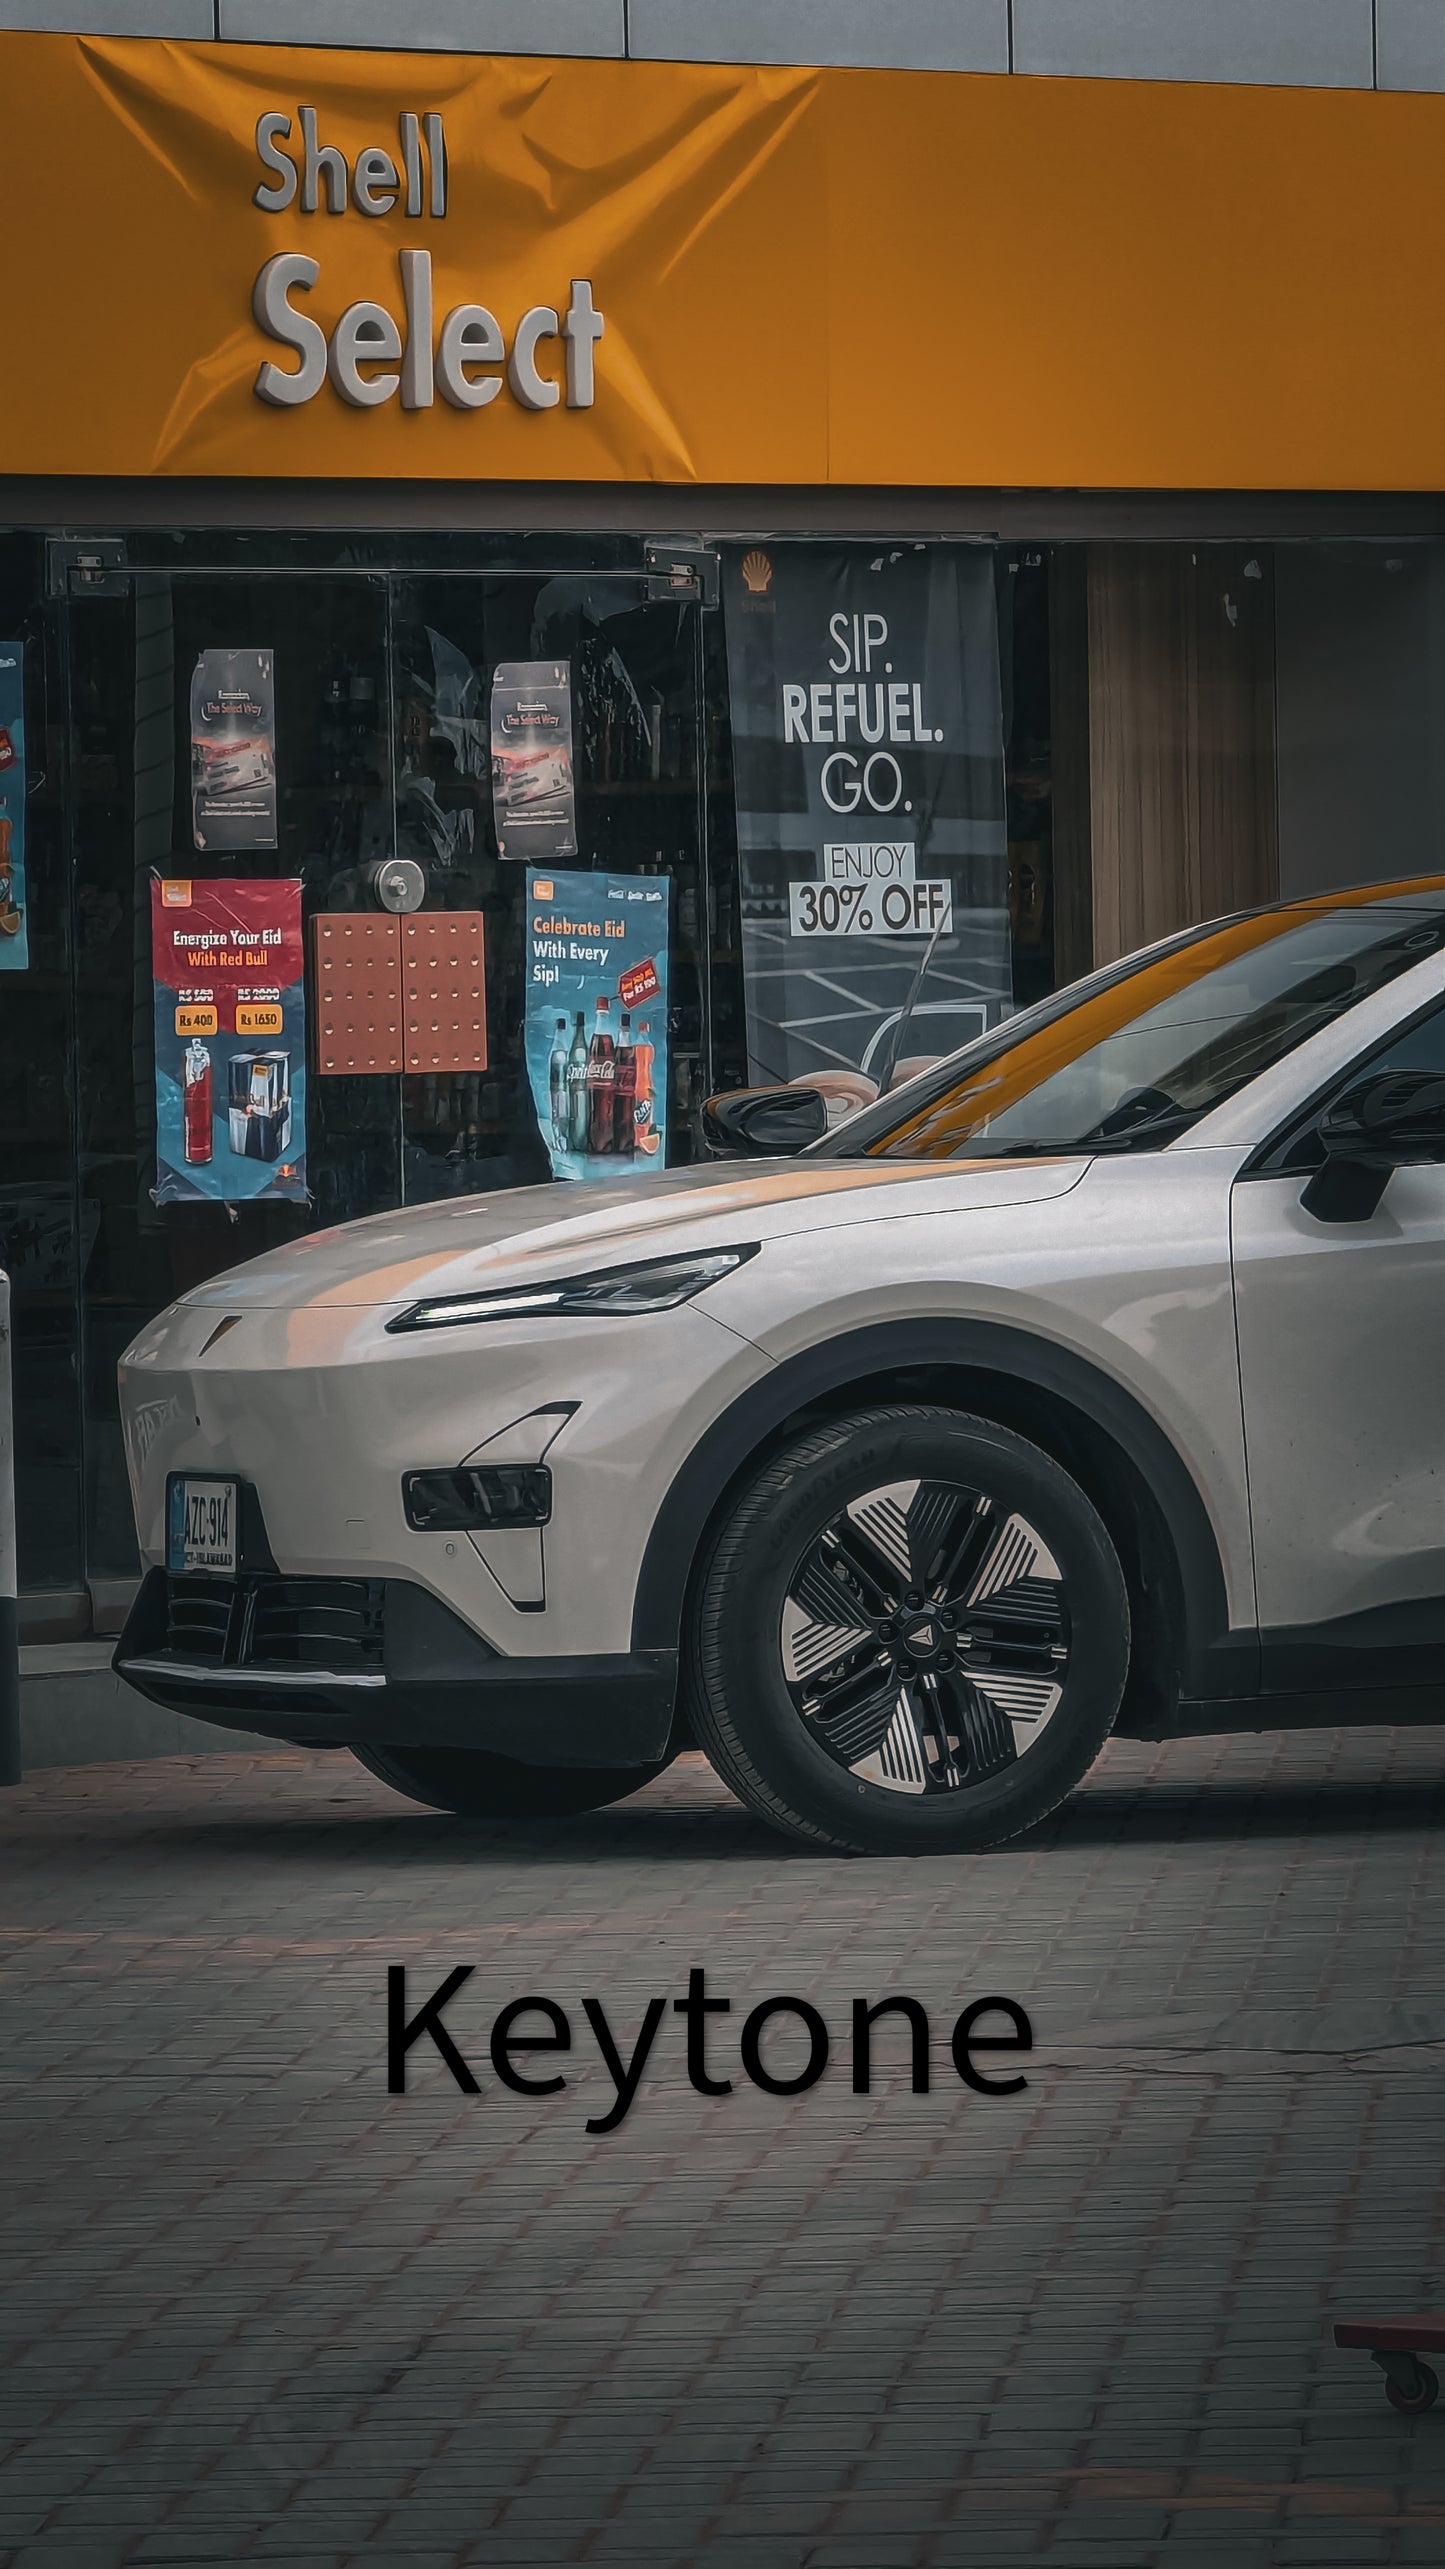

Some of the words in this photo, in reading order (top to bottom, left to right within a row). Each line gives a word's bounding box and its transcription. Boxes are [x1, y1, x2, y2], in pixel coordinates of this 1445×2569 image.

[253, 105, 449, 219] Shell
[252, 248, 605, 411] Select
[828, 612, 893, 675] SIP.
[783, 683, 945, 744] REFUEL.
[820, 751, 913, 813] GO.
[831, 846, 907, 879] ENJOY
[798, 884, 874, 934] 30%
[880, 883, 947, 930] OFF
[173, 930, 227, 949] Energize
[230, 930, 260, 945] Your
[263, 928, 282, 945] Eid
[533, 916, 600, 937] Celebrate
[604, 920, 625, 938] Eid
[187, 951, 217, 967] With
[220, 951, 243, 966] Red
[246, 950, 268, 966] Bull
[533, 940, 566, 959] With
[570, 942, 609, 966] Every
[179, 1014, 191, 1027] Rs
[193, 1014, 213, 1026] 400
[240, 1014, 251, 1026] Rs
[254, 1013, 277, 1025] 1650
